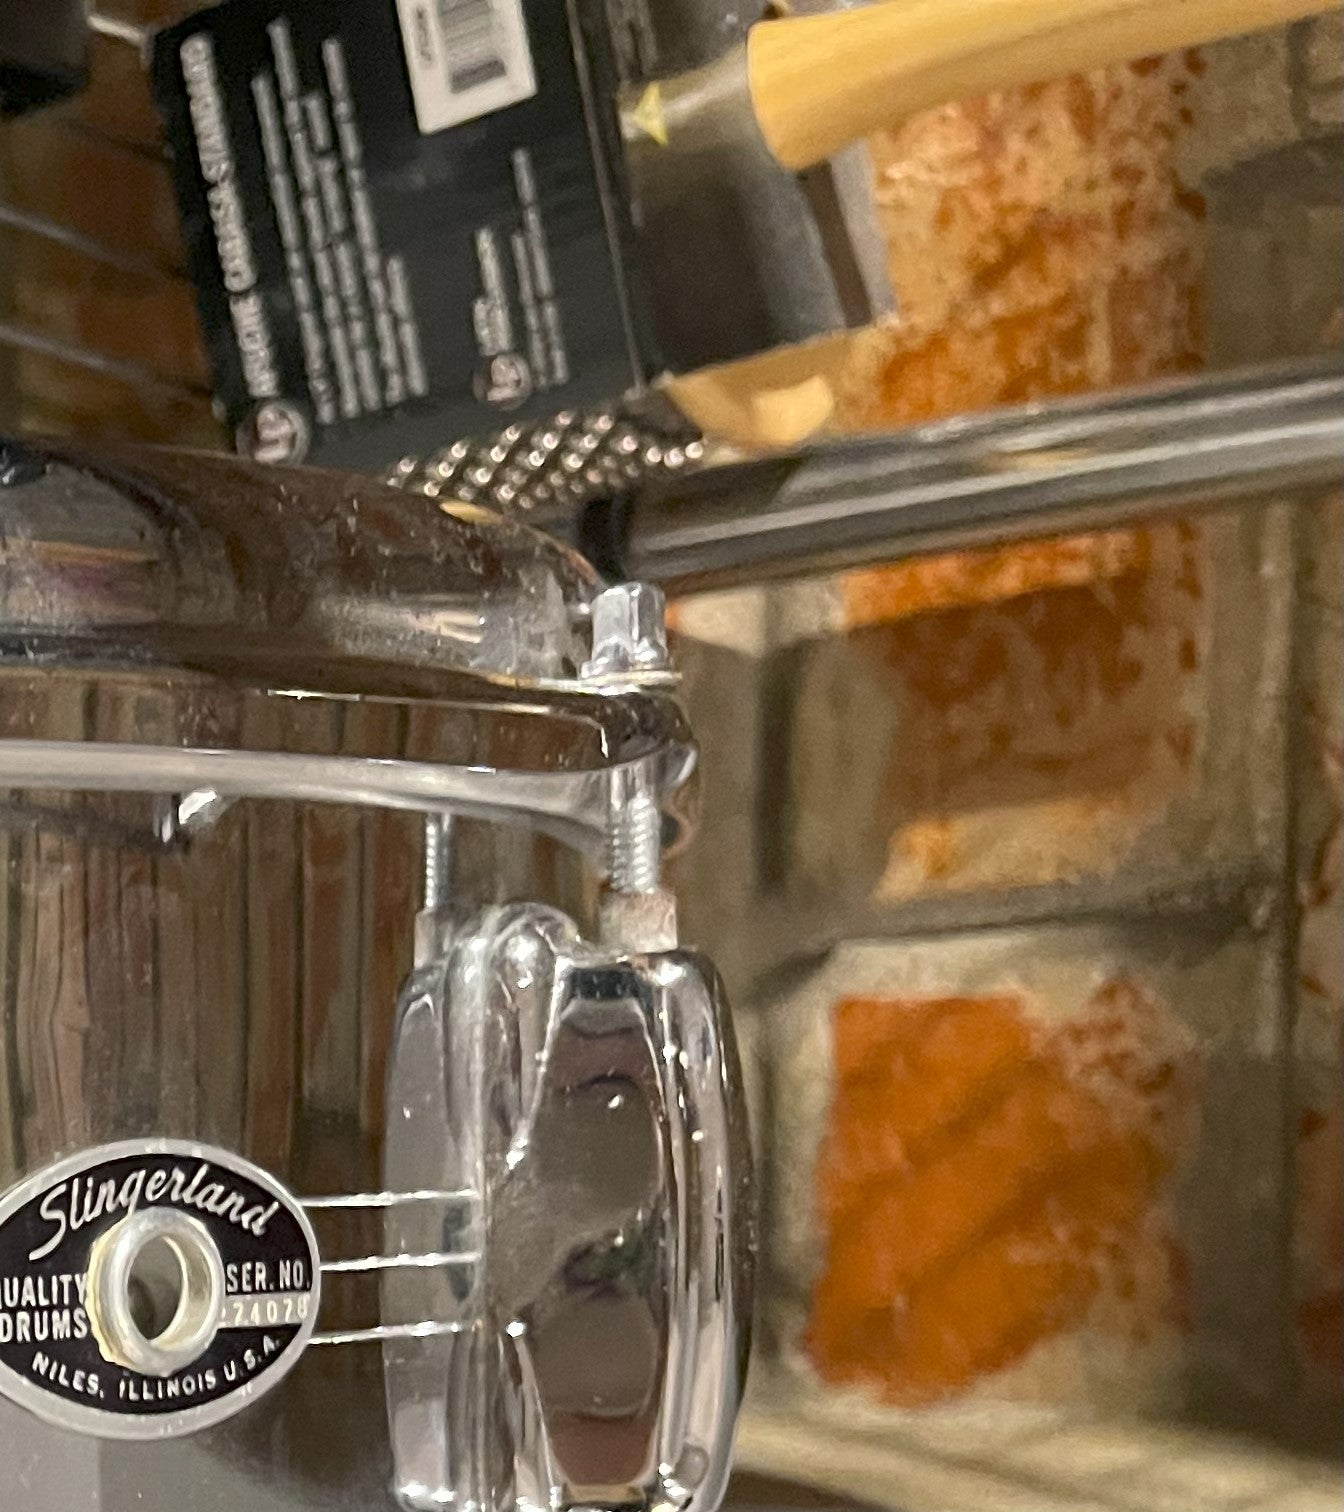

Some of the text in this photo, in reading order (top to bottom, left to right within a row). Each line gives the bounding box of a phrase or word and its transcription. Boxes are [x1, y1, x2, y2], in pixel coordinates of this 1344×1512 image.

[28, 1163, 279, 1261] Slingerland
[226, 1257, 311, 1293] SER. NO.
[118, 1368, 216, 1401] ILLINOIS
